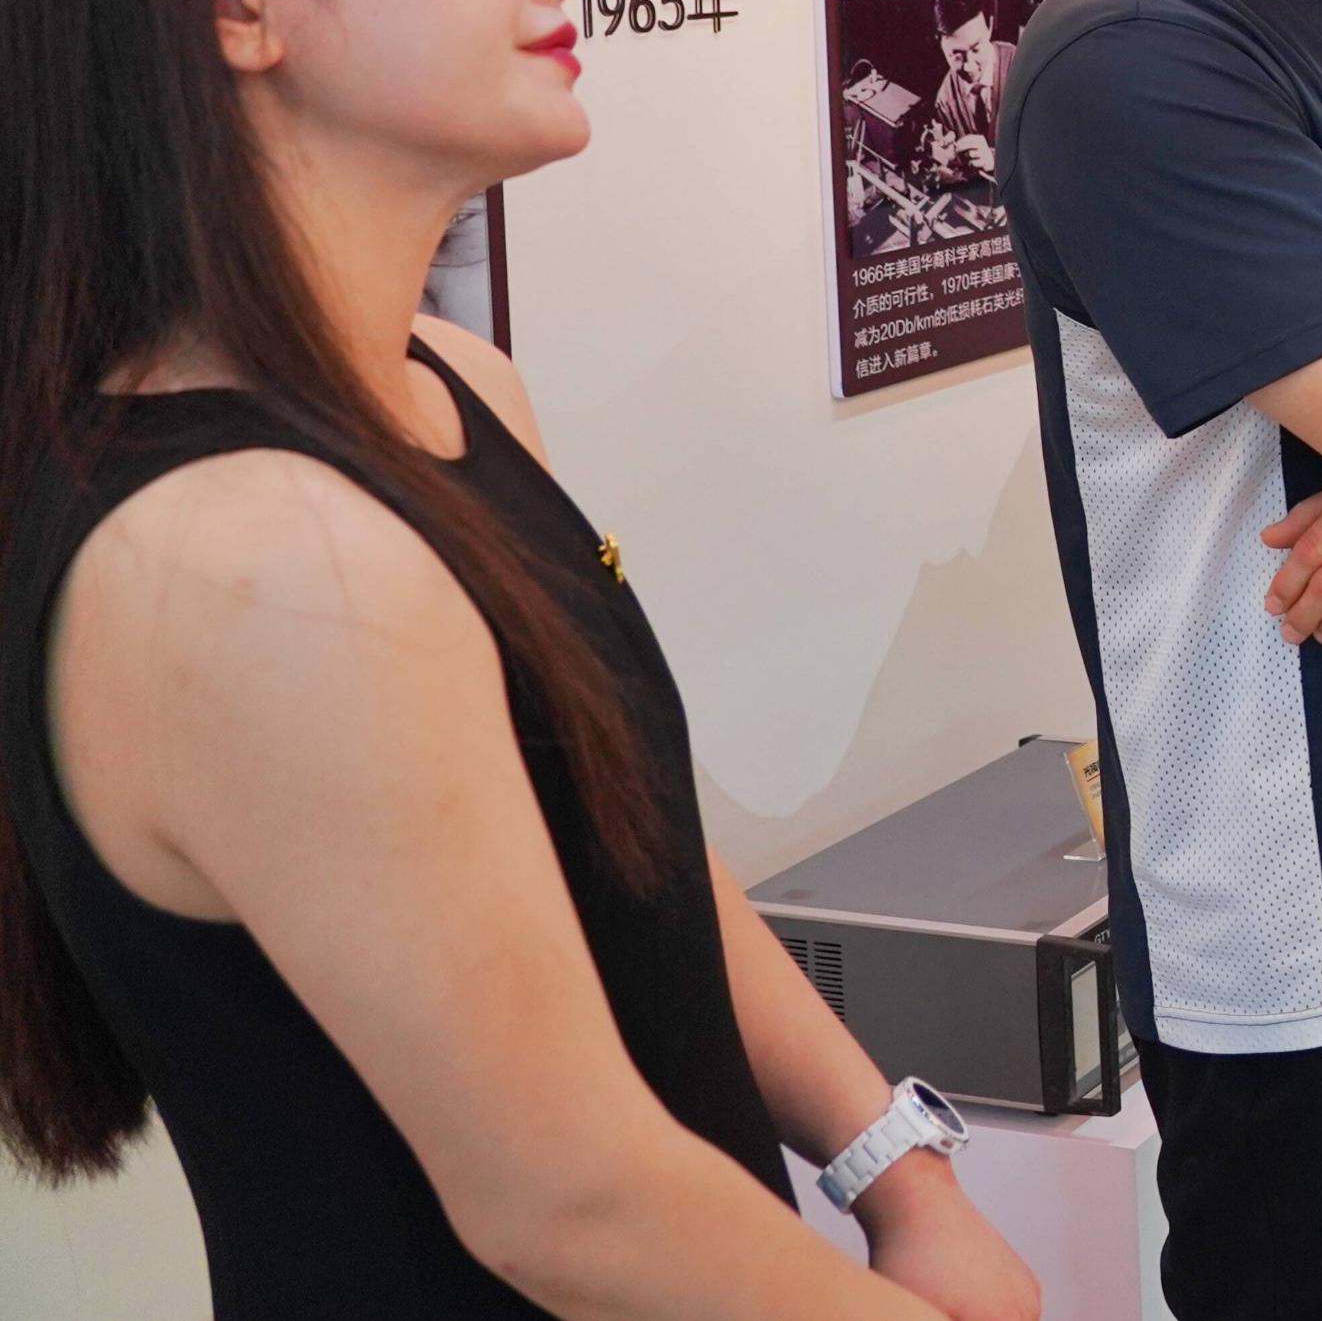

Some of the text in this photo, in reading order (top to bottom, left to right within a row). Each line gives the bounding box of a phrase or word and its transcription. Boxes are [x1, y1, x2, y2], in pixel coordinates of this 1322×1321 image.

[855, 342, 939, 379] 信进入新篇章。
